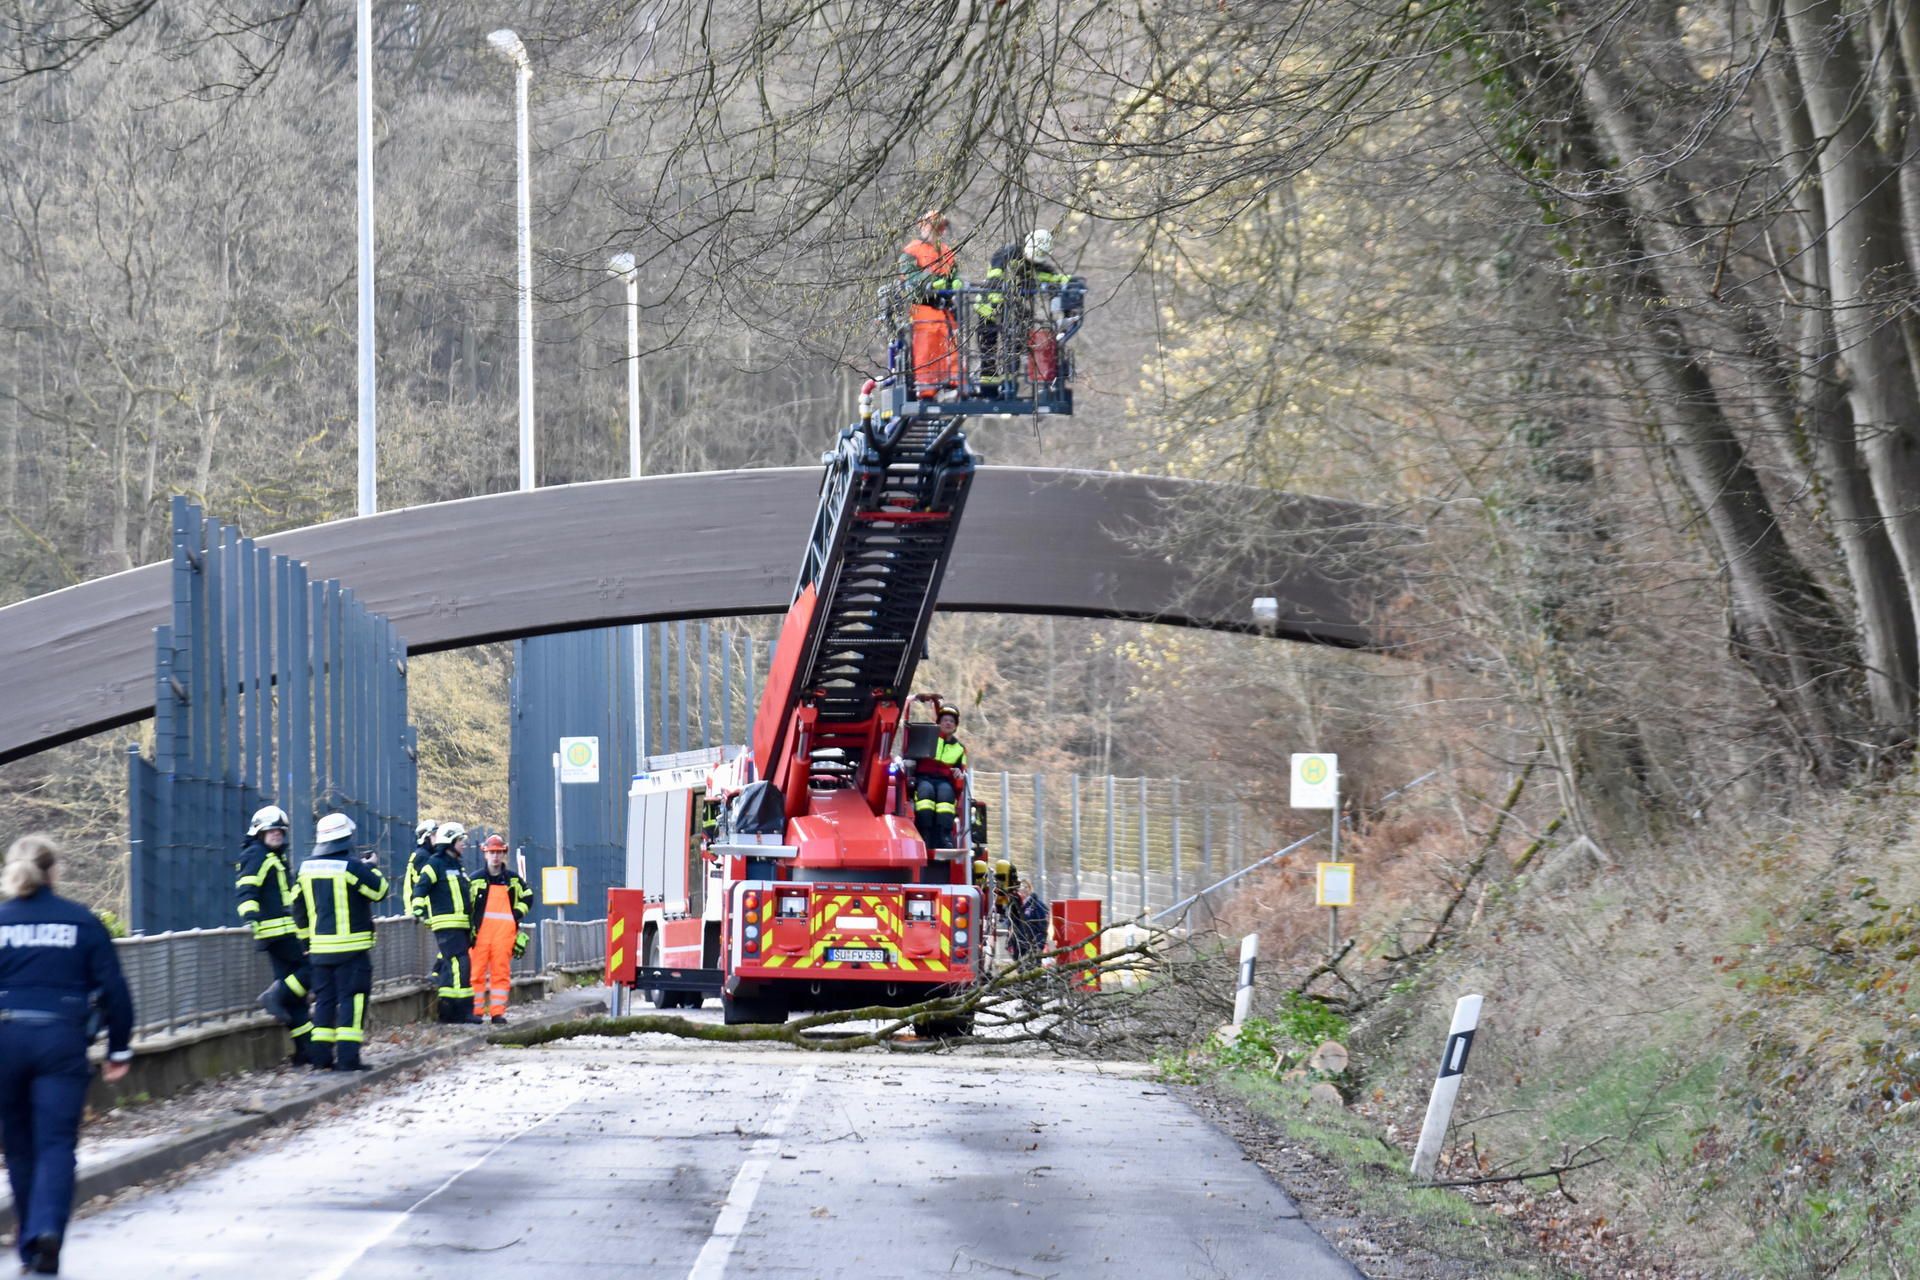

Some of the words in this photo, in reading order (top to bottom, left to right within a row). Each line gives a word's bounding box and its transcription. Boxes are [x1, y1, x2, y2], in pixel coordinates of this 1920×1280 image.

[0, 924, 78, 948] POLIZEI
[834, 950, 847, 960] SU
[851, 950, 864, 960] FW
[865, 951, 882, 961] 533
